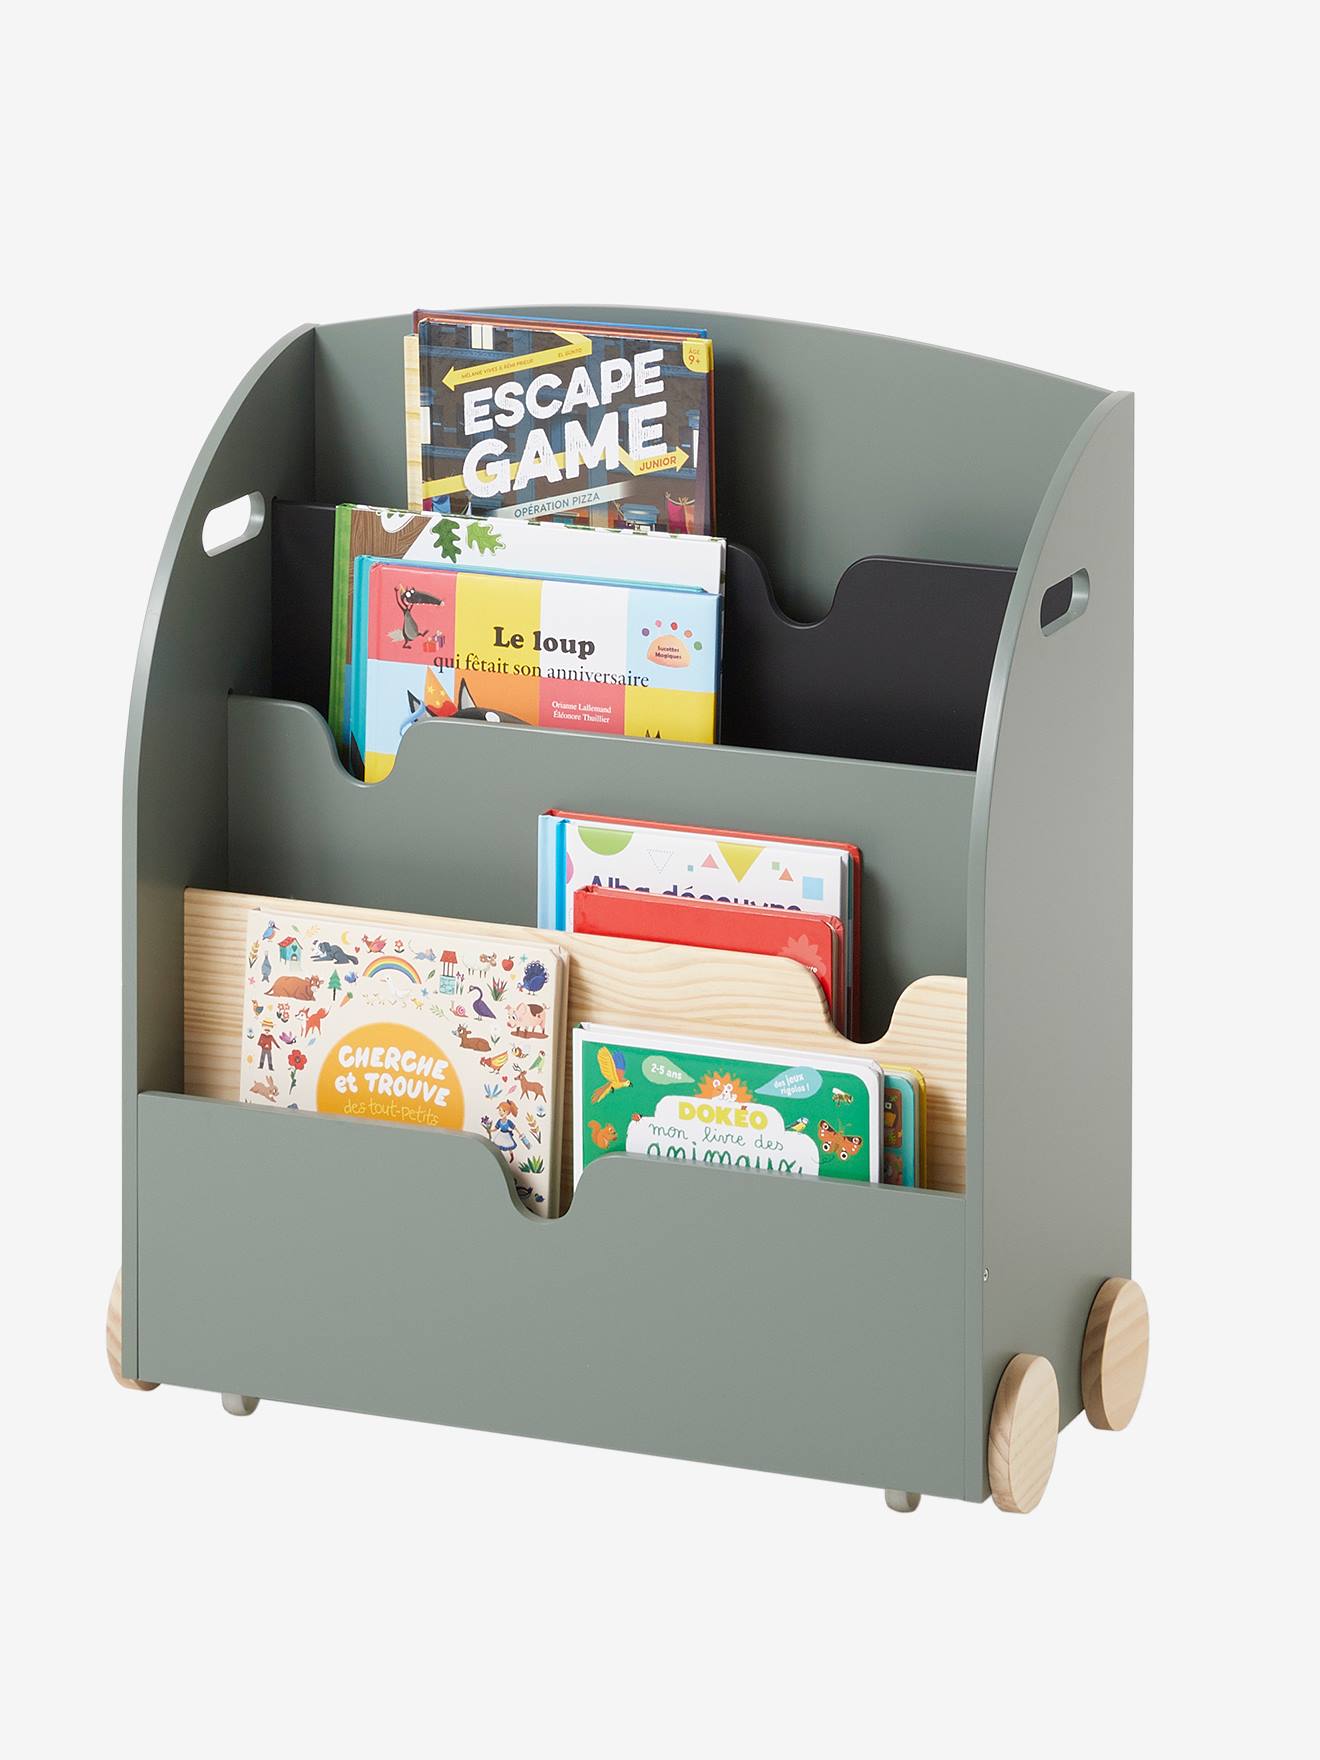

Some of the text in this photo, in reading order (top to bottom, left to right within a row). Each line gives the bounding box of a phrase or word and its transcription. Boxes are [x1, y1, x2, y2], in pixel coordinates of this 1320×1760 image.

[688, 355, 700, 365] 9+
[463, 349, 664, 436] ESCAPE
[462, 400, 668, 498] GAME
[639, 455, 678, 472] JUNIOR
[514, 492, 601, 519] OPÉRATION PIZZA
[493, 626, 596, 660] Le loup
[433, 652, 650, 688] qui fêtait son anniversaire
[551, 699, 612, 714] Orianne Lallemand
[552, 709, 581, 721] Éléonore
[338, 1045, 449, 1080] CHERCHE
[650, 1062, 683, 1080] 2-5 ans
[334, 1071, 451, 1107] et TROUVE
[773, 1072, 806, 1090] des jeux
[343, 1097, 440, 1126] des tout-petits
[648, 1123, 784, 1152] mon livre des
